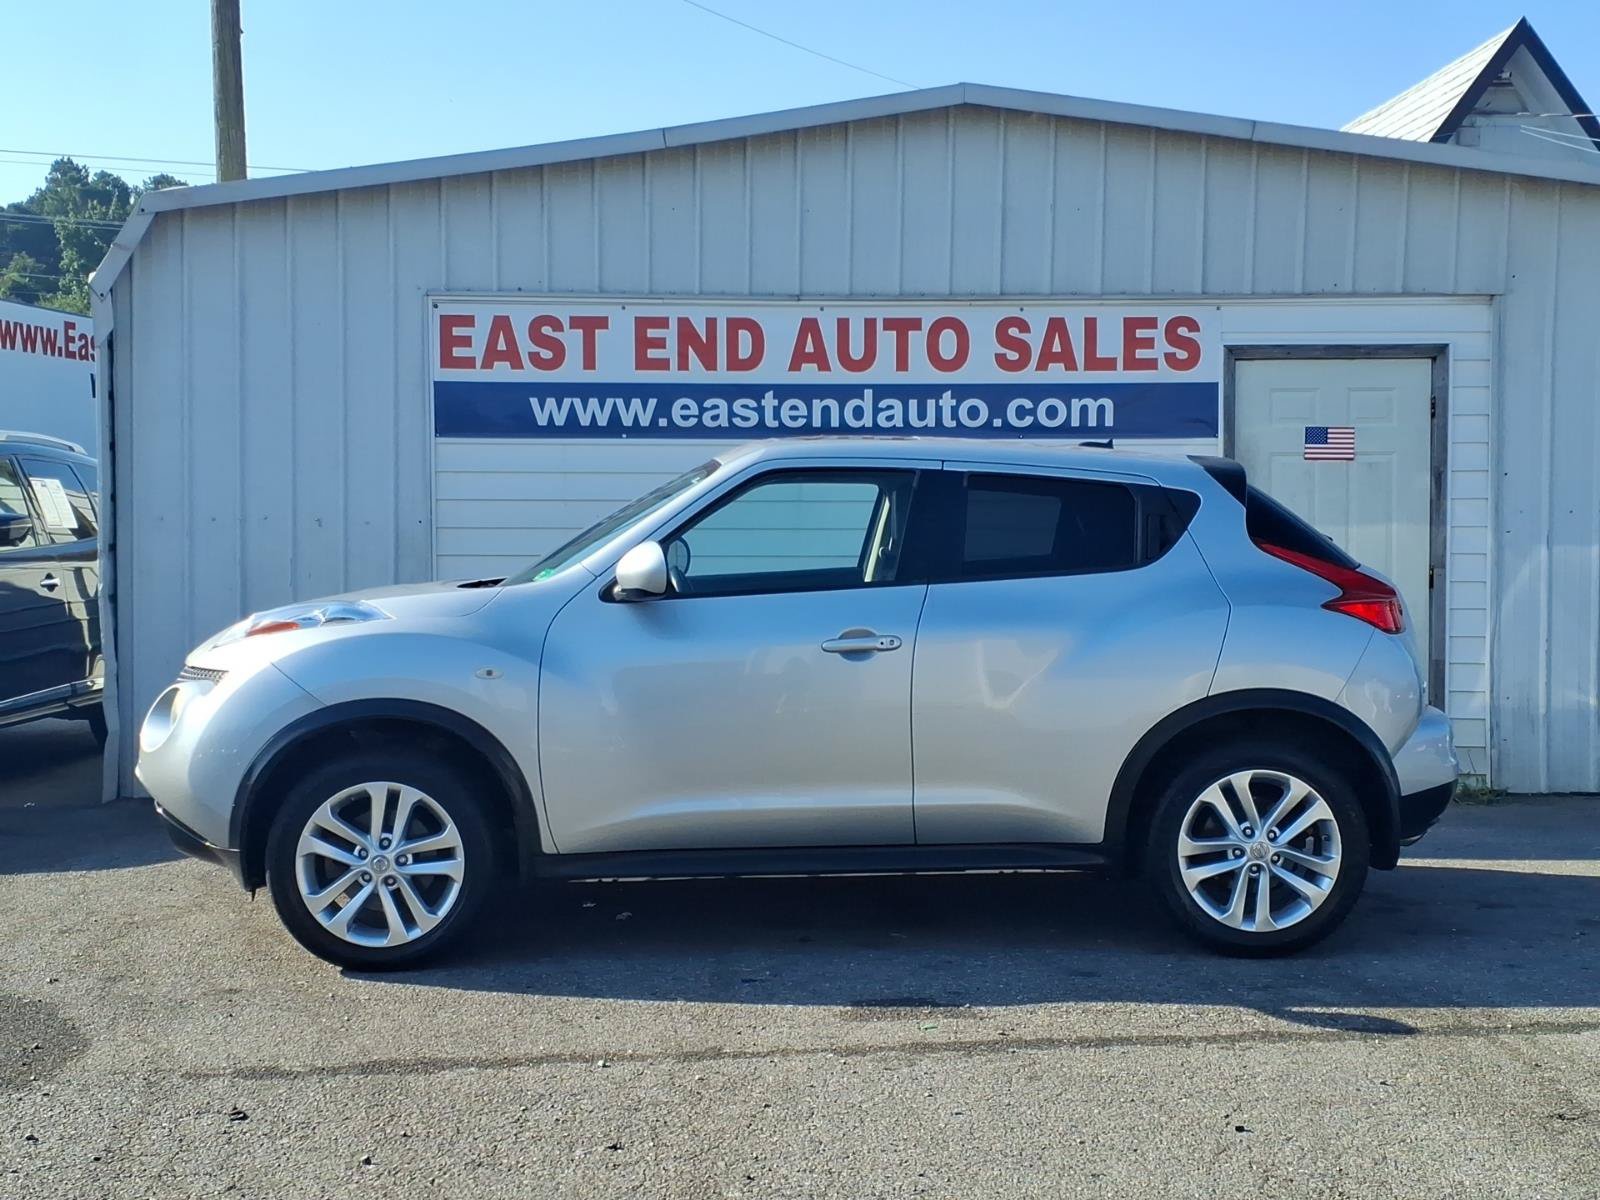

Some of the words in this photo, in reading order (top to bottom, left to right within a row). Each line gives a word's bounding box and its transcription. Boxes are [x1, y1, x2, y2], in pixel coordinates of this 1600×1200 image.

[439, 314, 609, 371] EAST
[634, 315, 766, 372] END
[787, 316, 970, 373] AUTO
[993, 315, 1201, 372] SALES
[529, 389, 1114, 428] www.eastendauto.com
